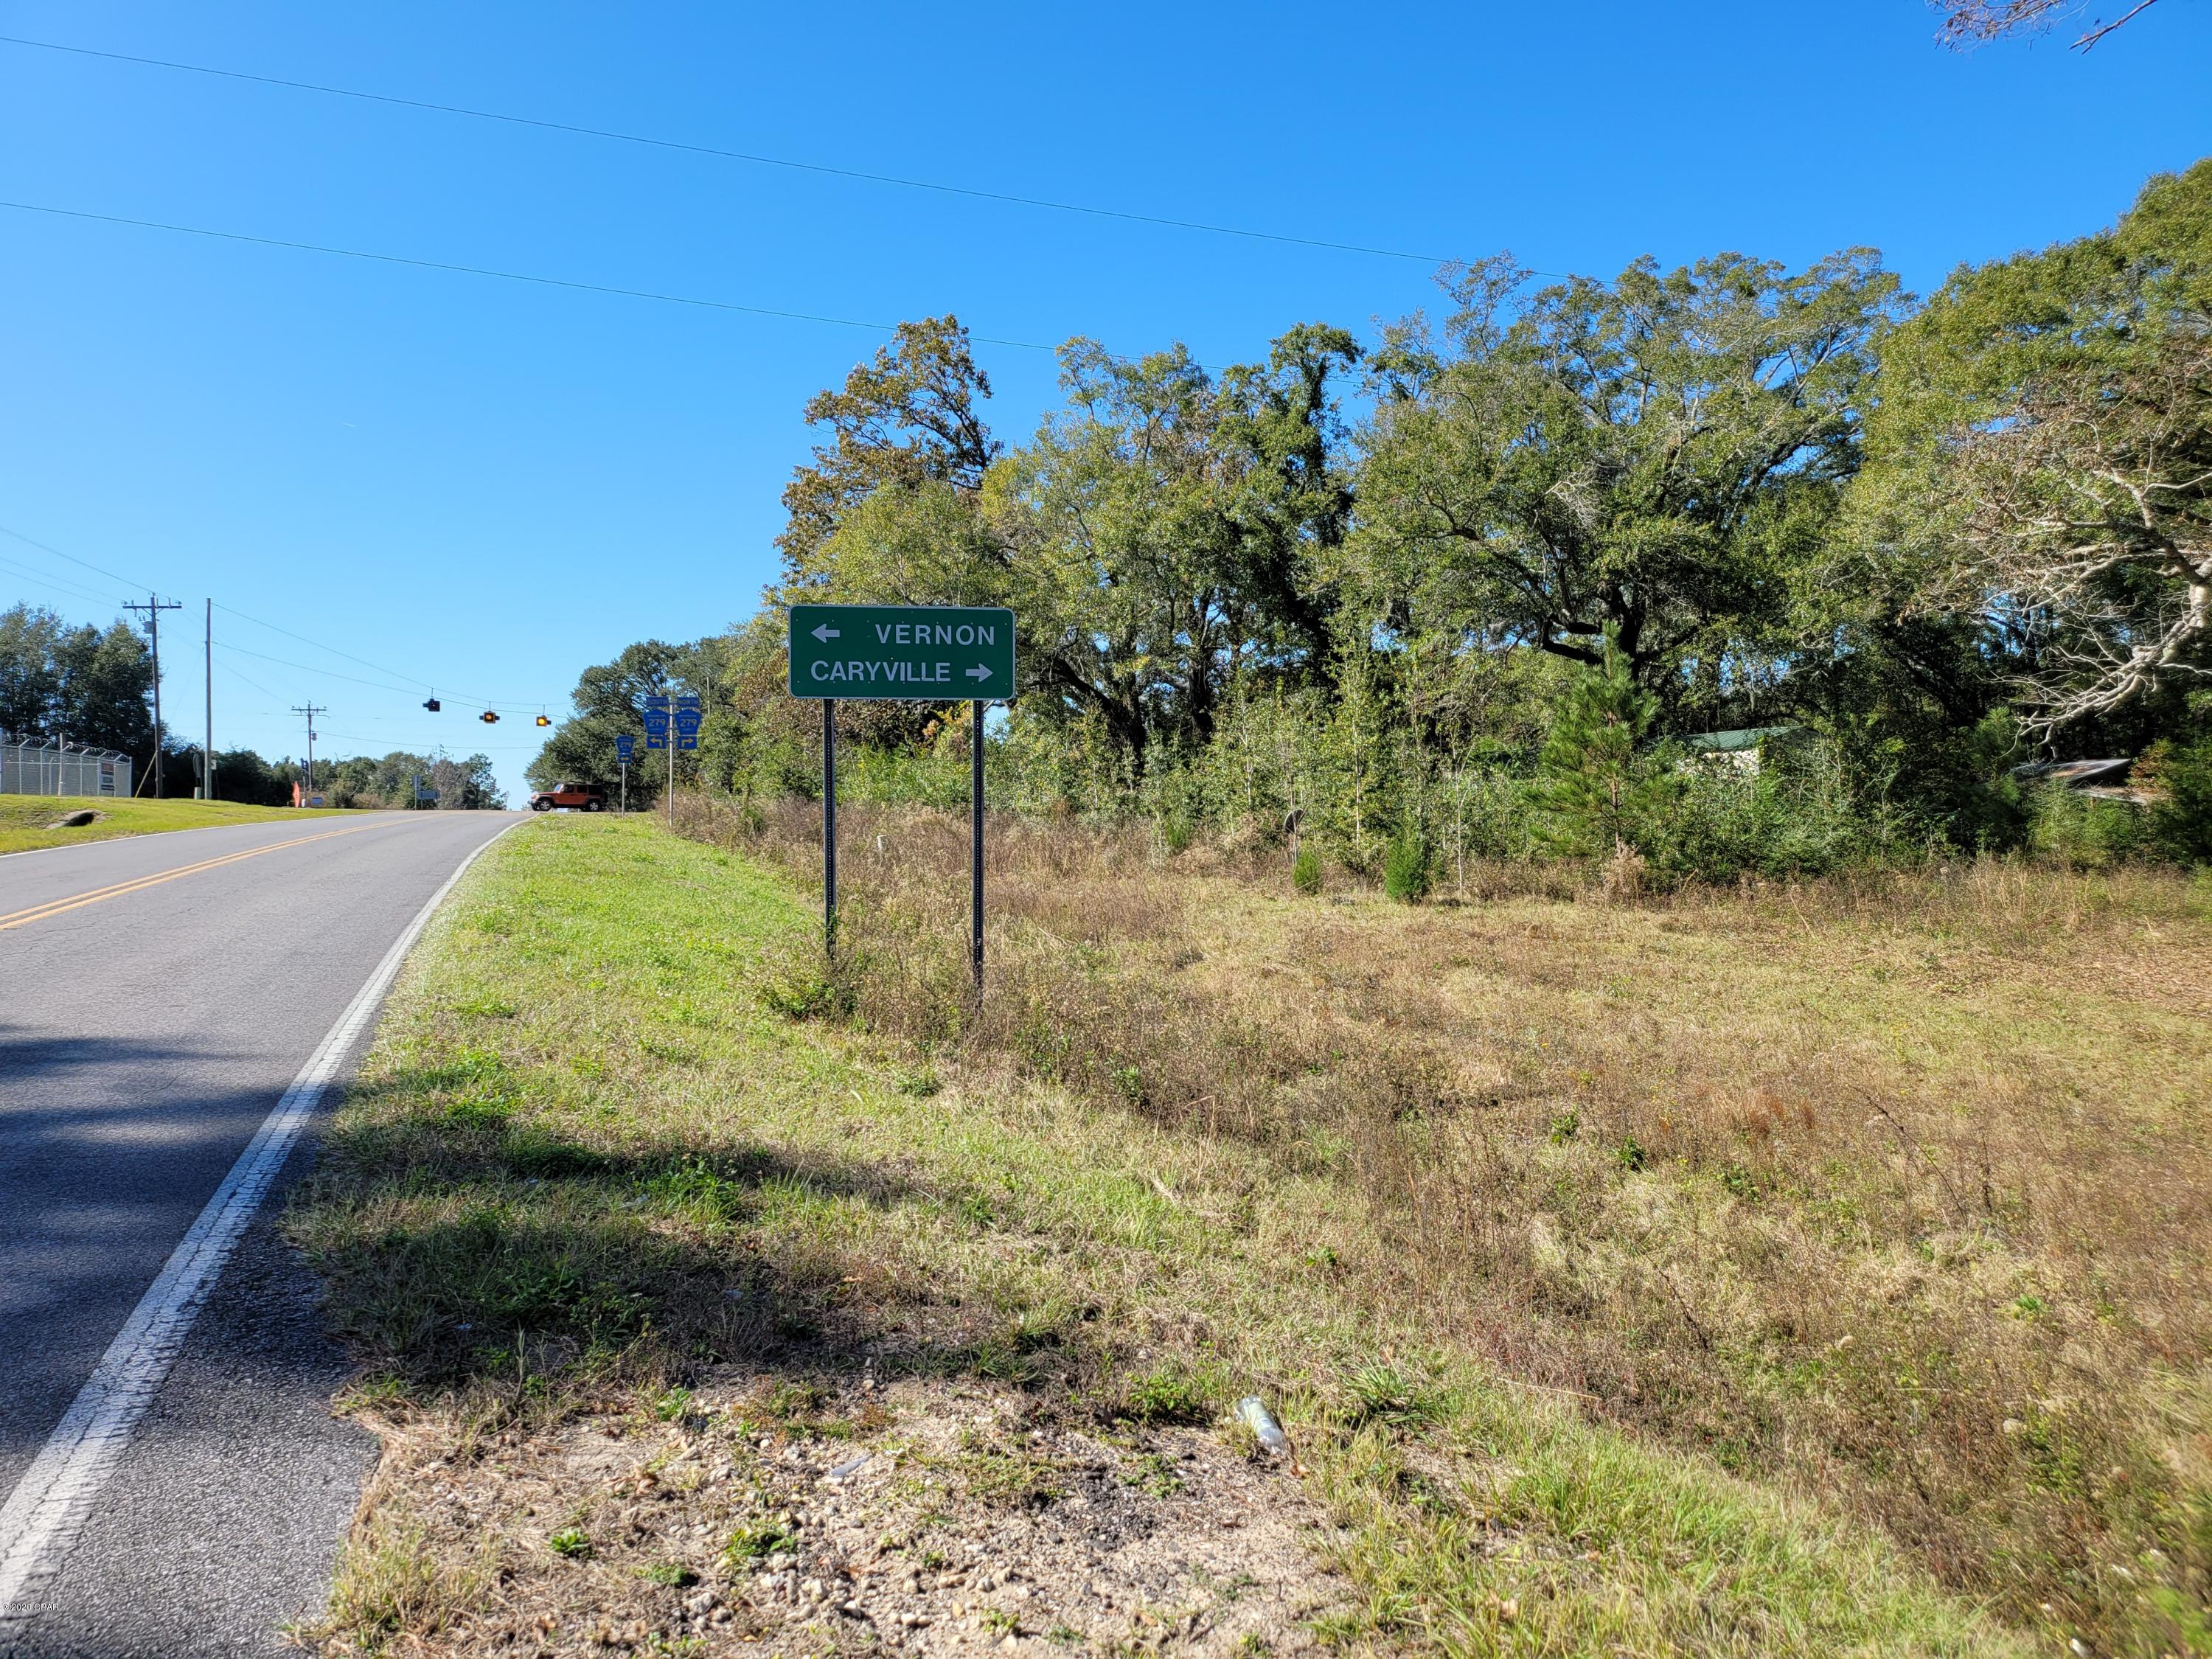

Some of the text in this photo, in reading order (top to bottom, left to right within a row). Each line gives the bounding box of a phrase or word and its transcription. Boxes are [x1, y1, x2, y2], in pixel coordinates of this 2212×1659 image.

[875, 624, 995, 645] VERNON
[810, 660, 950, 682] CARYVILLE
[648, 718, 666, 727] 279
[680, 718, 698, 727] 279
